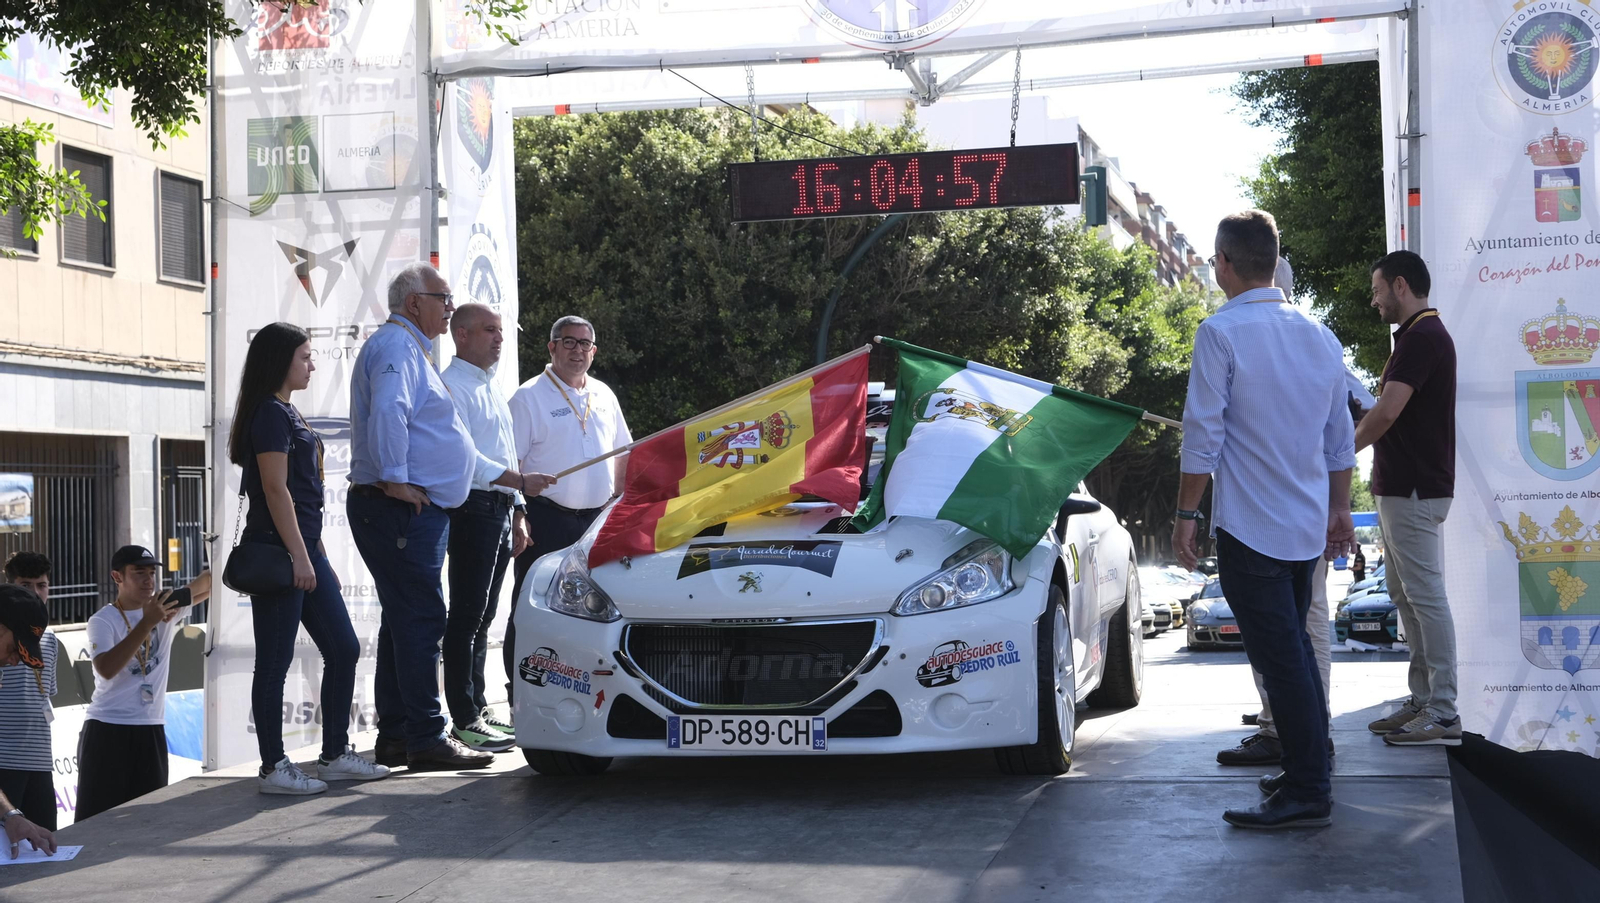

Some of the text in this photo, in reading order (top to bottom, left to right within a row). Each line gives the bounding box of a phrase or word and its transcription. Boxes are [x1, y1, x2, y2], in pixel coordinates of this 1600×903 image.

[536, 13, 639, 40] ALMERÍA
[832, 16, 843, 27] de
[903, 29, 915, 39] de
[1500, 1, 1600, 46] AUTOMOVIL CLU
[1523, 94, 1588, 112] ALMERIA
[256, 144, 310, 167] UNED
[791, 152, 1006, 215] 16:04:57
[1464, 232, 1580, 254] Ayuntamiento
[1478, 261, 1542, 284] Corazón
[1546, 253, 1571, 273] del
[1536, 371, 1591, 380] ALBOLODUY
[1494, 490, 1564, 503] Ayuntamiento
[1565, 490, 1579, 499] de
[960, 650, 1021, 675] PEDRO RUIZ
[547, 671, 591, 696] PEDRO RUIZ
[1483, 683, 1553, 694] Ayuntamiento
[1554, 683, 1568, 692] de
[671, 737, 677, 745] F
[815, 739, 825, 747] 32
